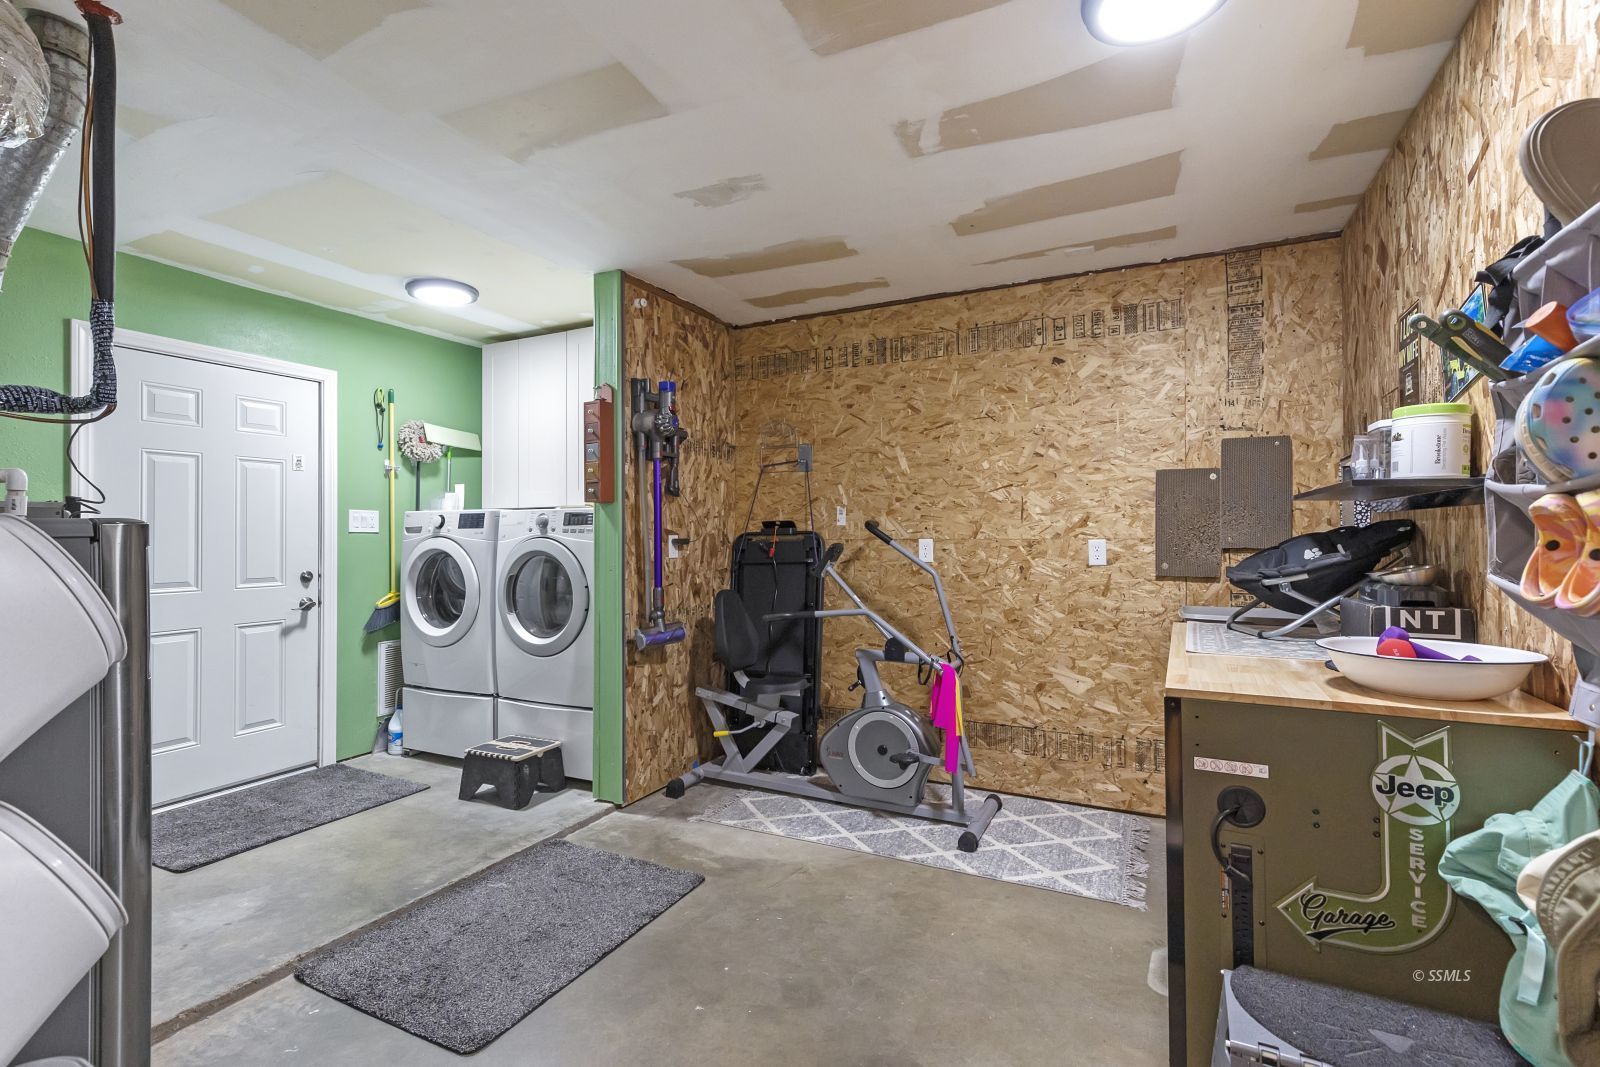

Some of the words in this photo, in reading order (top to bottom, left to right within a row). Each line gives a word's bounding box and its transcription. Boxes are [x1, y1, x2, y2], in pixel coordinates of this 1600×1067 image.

[1376, 775, 1454, 805] Jeep
[1408, 828, 1427, 928] SERVICE
[1300, 893, 1396, 934] Garage
